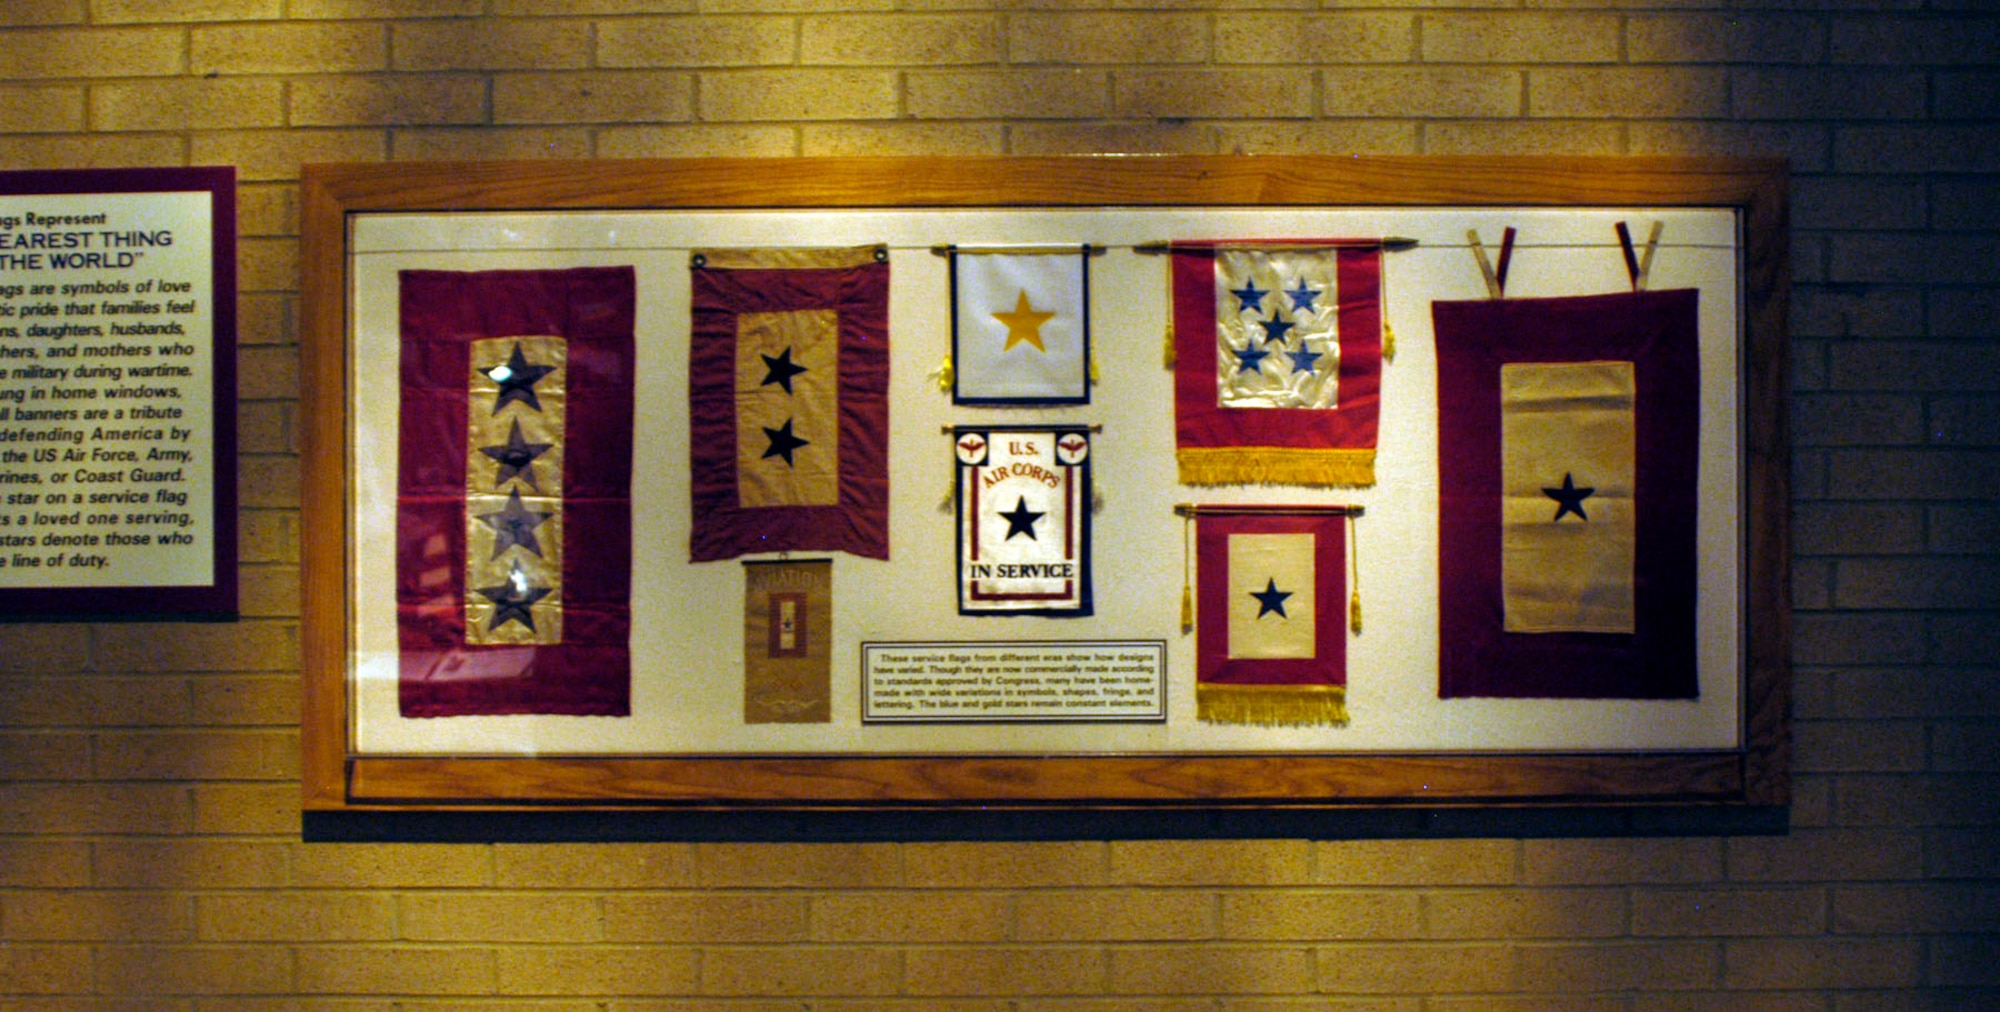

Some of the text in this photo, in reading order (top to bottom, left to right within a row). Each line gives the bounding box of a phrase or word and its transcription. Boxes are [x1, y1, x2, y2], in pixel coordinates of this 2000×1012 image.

[0, 213, 106, 230] gs Represent
[0, 231, 172, 249] EAREST THING
[0, 254, 42, 270] THE
[30, 284, 54, 295] are
[62, 280, 129, 297] symbols
[136, 280, 152, 293] of
[158, 280, 191, 293] love
[20, 303, 58, 318] pride
[65, 303, 94, 315] that
[101, 301, 160, 315] families
[166, 300, 194, 314] feel
[27, 324, 103, 340] daughters,
[110, 322, 185, 336] husbands,
[46, 344, 77, 357] and
[83, 344, 152, 357] mothers
[159, 344, 194, 356] who
[12, 366, 67, 381] military
[74, 366, 122, 379] during
[128, 365, 192, 378] wartime.
[31, 387, 45, 399] in
[51, 387, 97, 399] home
[105, 385, 181, 399] windows,
[15, 408, 77, 420] banners
[84, 408, 108, 420] are
[114, 409, 123, 419] a
[130, 406, 182, 419] tribute
[91, 428, 162, 441] America
[170, 426, 191, 442] by
[3, 448, 193, 463] the US Air Force, Army,
[1009, 442, 1039, 455] U.S.
[51, 471, 68, 483] or
[74, 469, 124, 483] Coast
[130, 468, 185, 482] Guard.
[982, 463, 1061, 488] AIR CORPS
[7, 492, 40, 505] star
[46, 492, 66, 504] on
[72, 493, 83, 504] a
[89, 491, 149, 504] service
[156, 490, 188, 505] flag
[17, 514, 27, 525] a
[34, 512, 81, 525] loved
[87, 513, 119, 524] one
[126, 511, 194, 527] serving,
[42, 533, 99, 546] denote
[105, 533, 151, 545] those
[158, 532, 193, 545] who
[12, 554, 41, 567] line
[47, 554, 63, 567] of
[69, 554, 109, 569] duty.
[971, 564, 1073, 578] IN SERVICE
[948, 654, 971, 663] flags
[1000, 653, 1040, 661] different
[1118, 653, 1154, 662] designs
[929, 666, 961, 675] Though
[965, 666, 983, 674] they
[1025, 665, 1081, 674] commercially
[1112, 665, 1154, 674] according
[936, 677, 979, 686] approved
[981, 677, 992, 685] by
[905, 688, 926, 696] with
[929, 688, 951, 696] wide
[955, 688, 1001, 696] variations
[1137, 687, 1154, 695] and
[919, 699, 937, 707] The
[939, 699, 959, 707] blue
[962, 699, 979, 707] and
[982, 699, 1002, 709] gold
[1031, 699, 1062, 707] remain
[1066, 699, 1106, 707] constant
